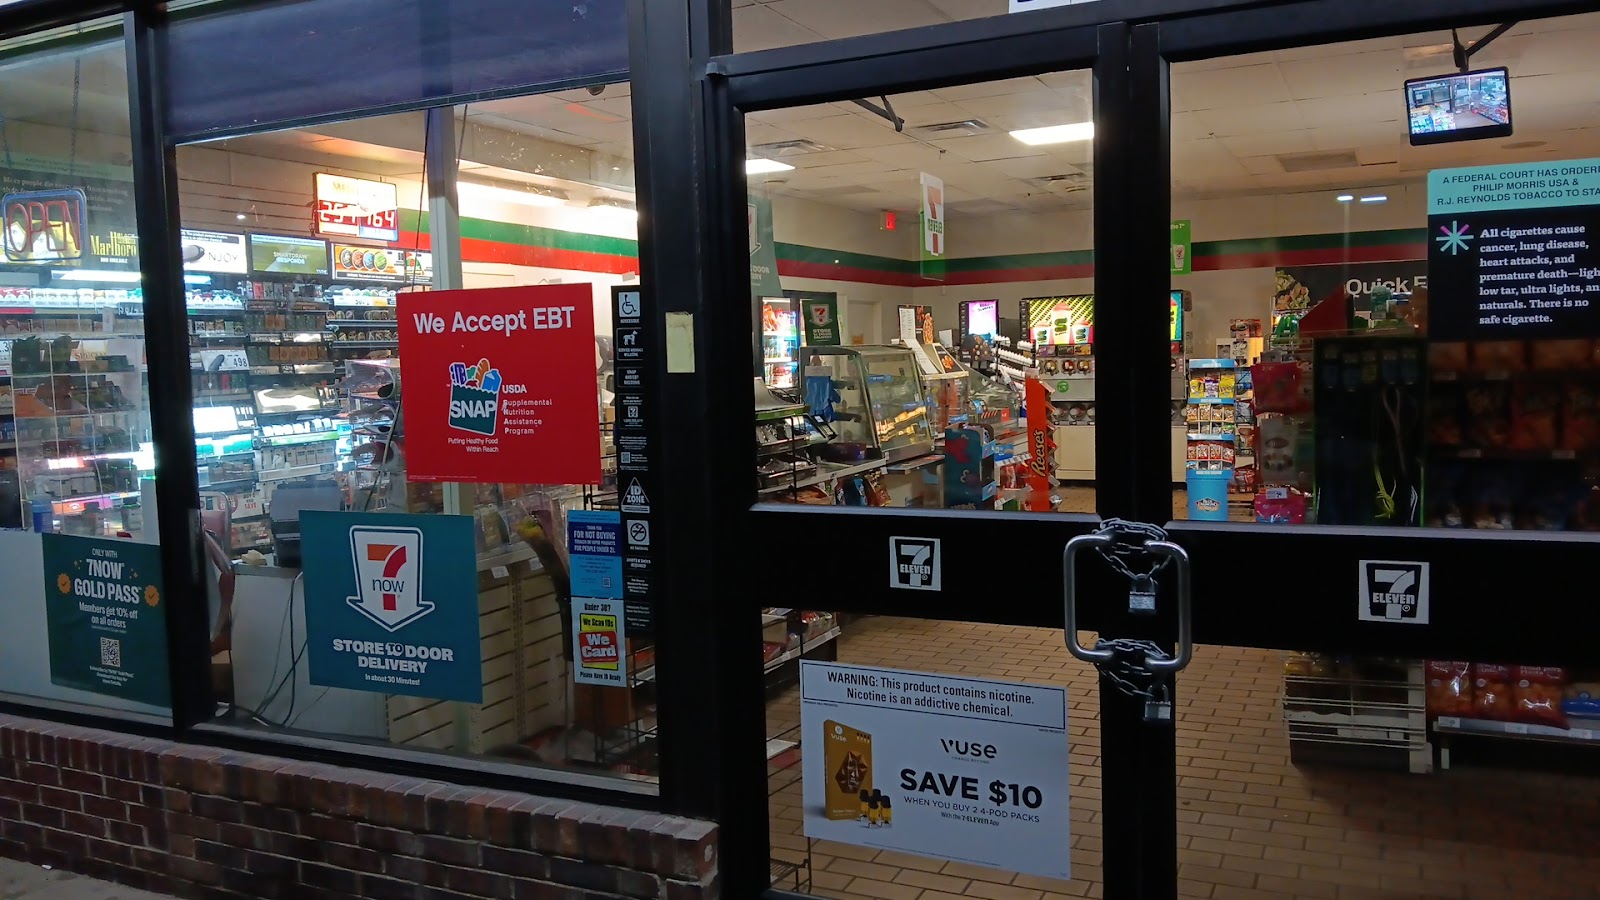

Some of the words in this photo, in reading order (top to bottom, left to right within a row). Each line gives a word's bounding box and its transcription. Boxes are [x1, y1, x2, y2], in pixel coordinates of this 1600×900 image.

[1452, 174, 1496, 183] FEDERAL
[1500, 170, 1534, 179] COURT
[1538, 168, 1558, 176] HAS
[1473, 183, 1504, 192] PHILIP
[1507, 180, 1546, 189] MORRIS
[1549, 179, 1569, 187] USA
[1458, 193, 1510, 204] REYNOLDS
[1513, 190, 1563, 200] TOBACCO
[8, 200, 80, 252] OPEN
[1480, 229, 1498, 238] All
[1500, 226, 1553, 239] cigarettes
[1555, 226, 1585, 235] cause
[90, 231, 136, 256] Marlboro
[1480, 243, 1517, 253] cancer,
[1520, 242, 1544, 254] lung
[1546, 240, 1589, 249] disease,
[209, 252, 238, 262] NJOY
[1480, 258, 1508, 267] heart
[1510, 256, 1552, 265] attacks,
[1554, 254, 1575, 264] and
[1479, 272, 1536, 283] premature
[1346, 277, 1409, 298] Quick
[1479, 286, 1499, 296] low
[1501, 286, 1519, 296] tar,
[1521, 284, 1547, 294] ultra
[1549, 282, 1584, 294] lights,
[1479, 300, 1527, 310] naturals.
[1529, 299, 1561, 308] There
[1563, 298, 1572, 307] is
[413, 312, 445, 334] We
[452, 310, 527, 336] Accept
[533, 306, 575, 330] EBT
[1479, 315, 1500, 324] safe
[1503, 313, 1553, 325] cigarette.
[502, 384, 527, 394] USDA
[450, 400, 497, 419] SNAP
[1030, 430, 1045, 477] Reese's
[630, 485, 641, 495] ID
[626, 495, 645, 504] ZONE
[585, 531, 595, 539] NOT
[92, 548, 104, 557] ONLY
[105, 550, 118, 558] WITH
[901, 544, 930, 586] 7
[367, 544, 407, 611] 7
[74, 578, 106, 599] GOLD
[108, 582, 140, 604] PASS
[372, 578, 404, 592] now
[1375, 569, 1415, 619] 7
[79, 602, 105, 615] Members
[106, 606, 115, 617] get
[116, 608, 128, 618] 10%
[130, 610, 138, 619] off
[584, 603, 599, 612] Under
[107, 617, 126, 628] orders
[586, 634, 610, 645] We
[332, 638, 384, 656] STORE
[405, 645, 454, 662] DOOR
[582, 645, 616, 657] Card
[358, 656, 428, 674] DELIVERY
[371, 674, 388, 683] about
[396, 676, 421, 686] Minutes!
[828, 672, 878, 687] WARNING:
[880, 677, 900, 690] This
[903, 682, 940, 694] product
[944, 687, 986, 699] contains
[989, 689, 1034, 704] nicotine.
[847, 688, 886, 702] Nicotine
[890, 692, 897, 703] is
[901, 696, 911, 705] an
[914, 696, 960, 710] addictive
[963, 702, 1013, 717] chemical.
[900, 768, 979, 800] SAVE
[989, 780, 1042, 809] $10
[904, 796, 930, 806] WHEN
[932, 800, 950, 809] YOU
[980, 807, 1008, 818] 4-POD
[1011, 812, 1040, 823] PACKS
